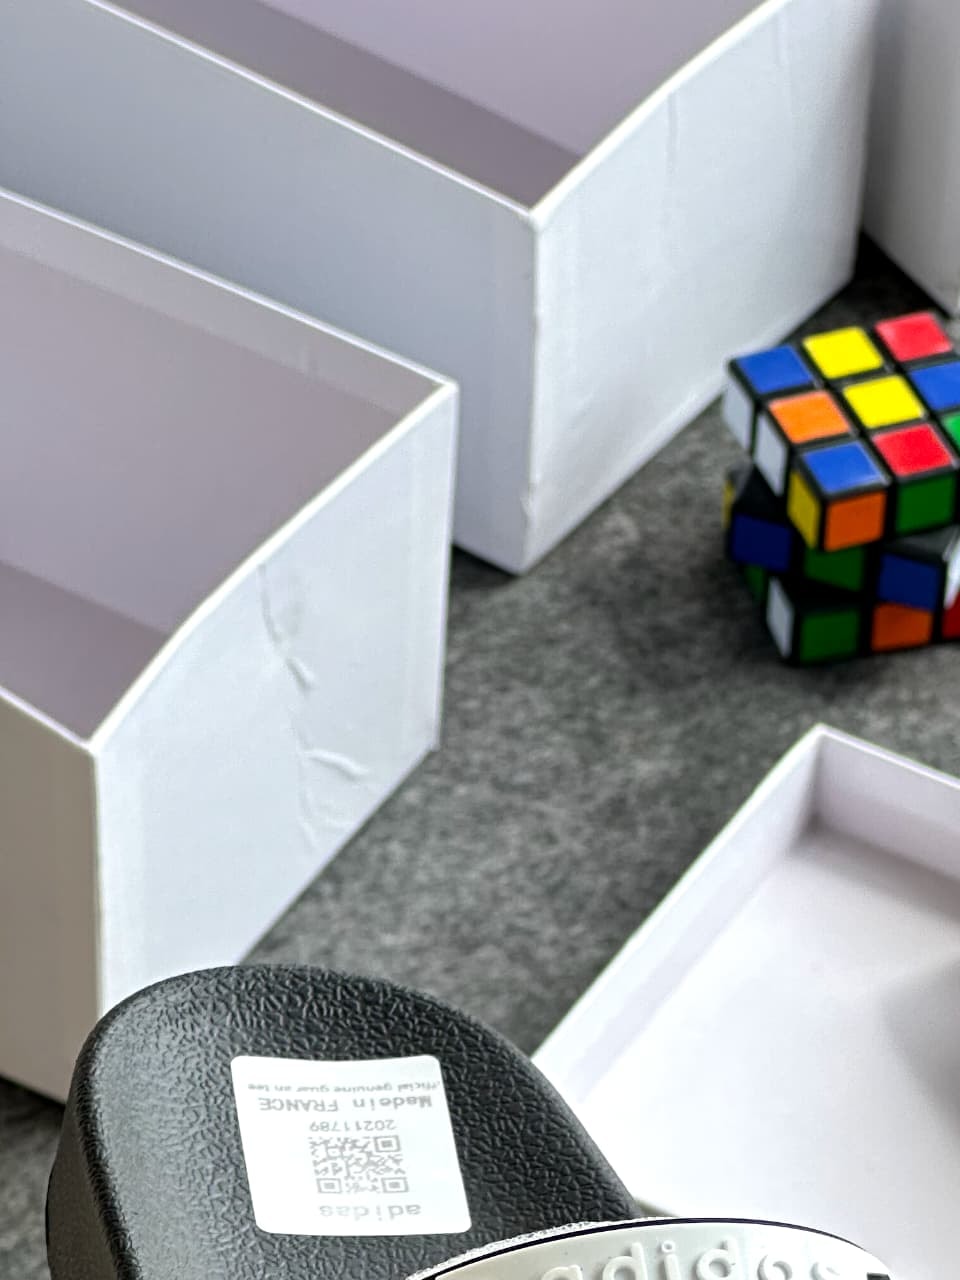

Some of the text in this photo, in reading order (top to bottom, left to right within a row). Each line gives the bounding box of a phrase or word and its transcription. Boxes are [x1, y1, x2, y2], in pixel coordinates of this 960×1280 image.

[333, 1082, 393, 1094] genuine
[397, 1080, 441, 1092] fficial
[258, 1097, 340, 1112] FRANCE
[309, 1119, 397, 1132] 20211789
[319, 1204, 422, 1221] adidas
